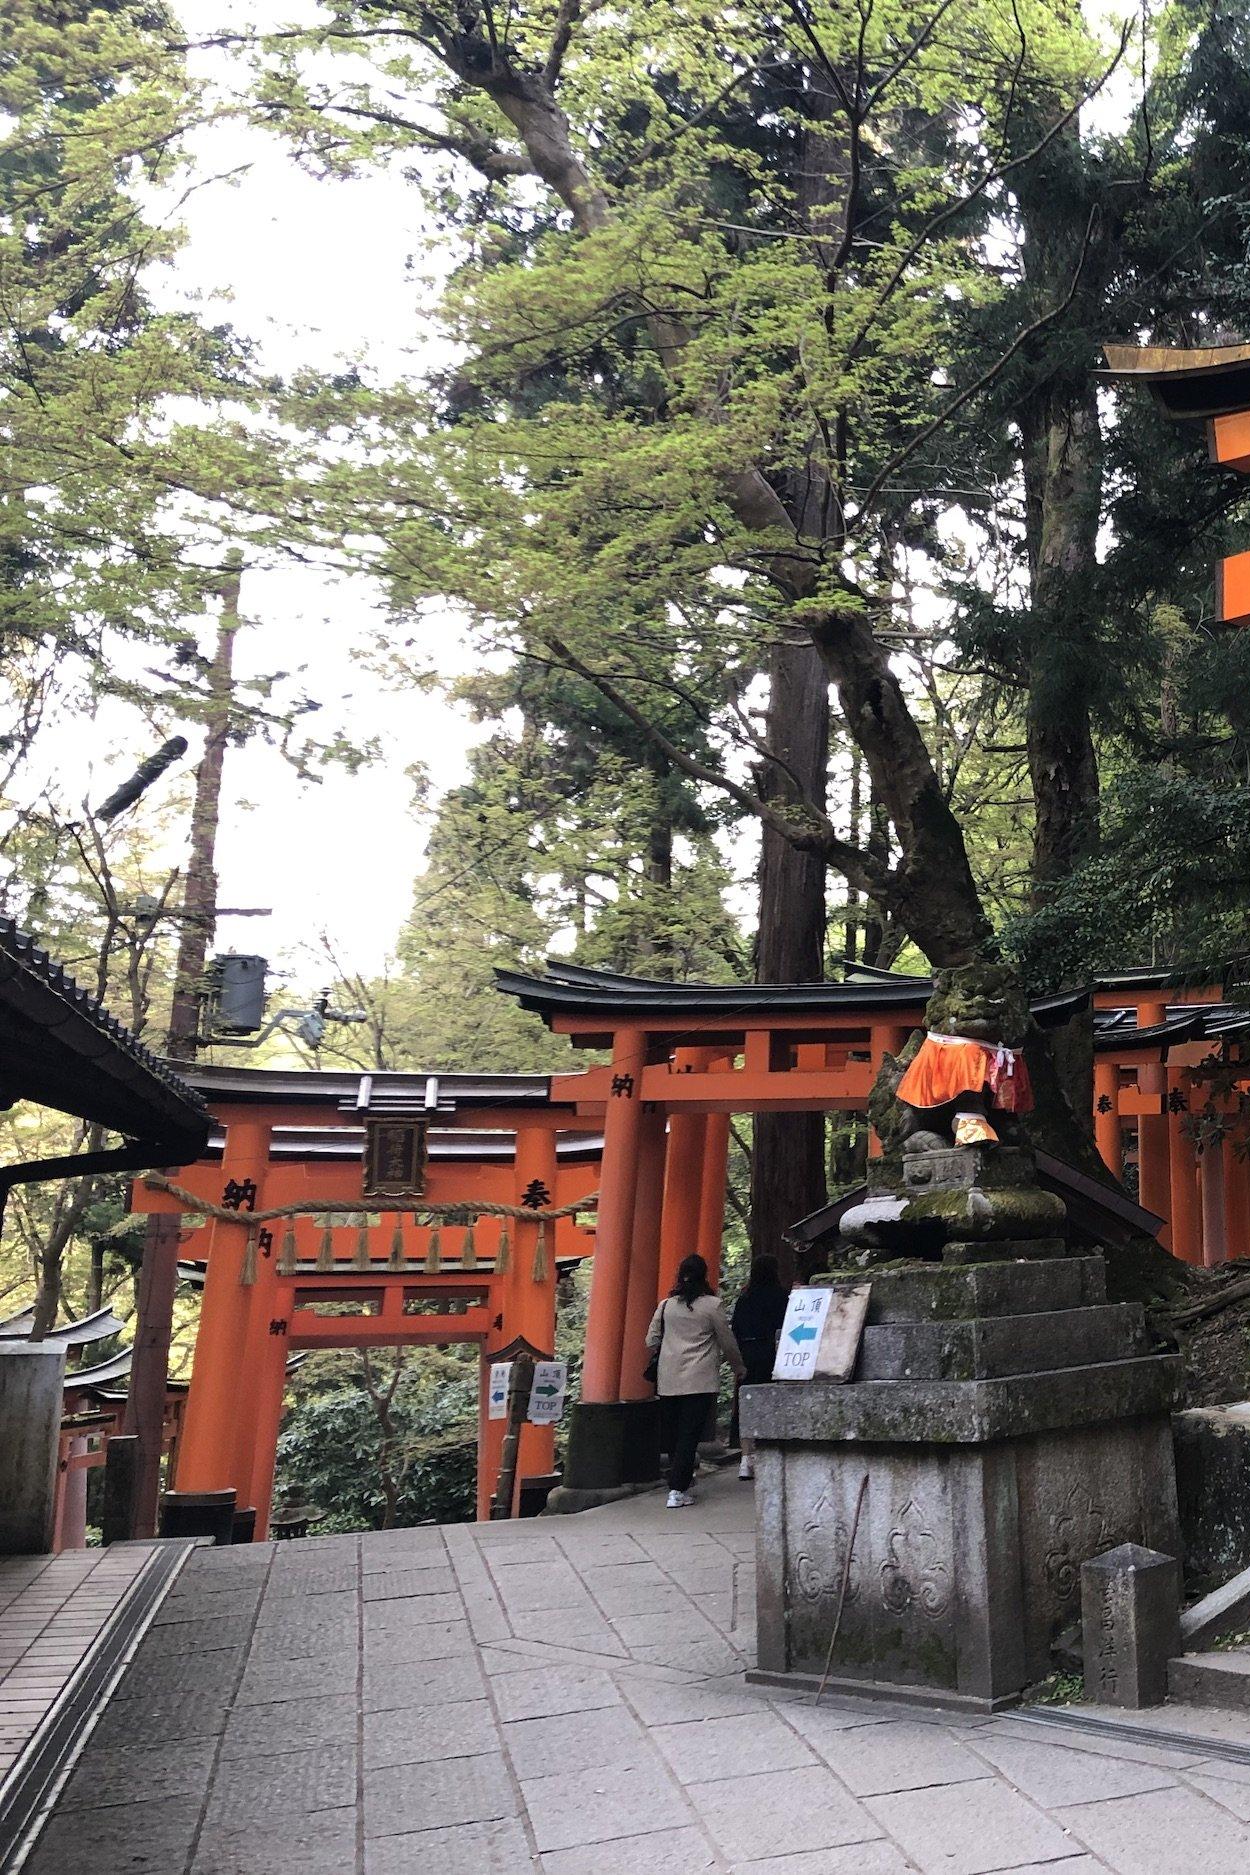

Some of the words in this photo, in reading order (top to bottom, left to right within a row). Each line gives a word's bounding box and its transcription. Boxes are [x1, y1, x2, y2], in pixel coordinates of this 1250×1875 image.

[611, 1073, 634, 1098] 納
[1097, 1094, 1113, 1115] 奉
[1169, 1087, 1188, 1115] 奉
[222, 1178, 257, 1211] 納
[521, 1179, 551, 1210] 奉
[270, 1319, 287, 1336] 納
[784, 1352, 810, 1367] TOP
[535, 1401, 556, 1410] TOP
